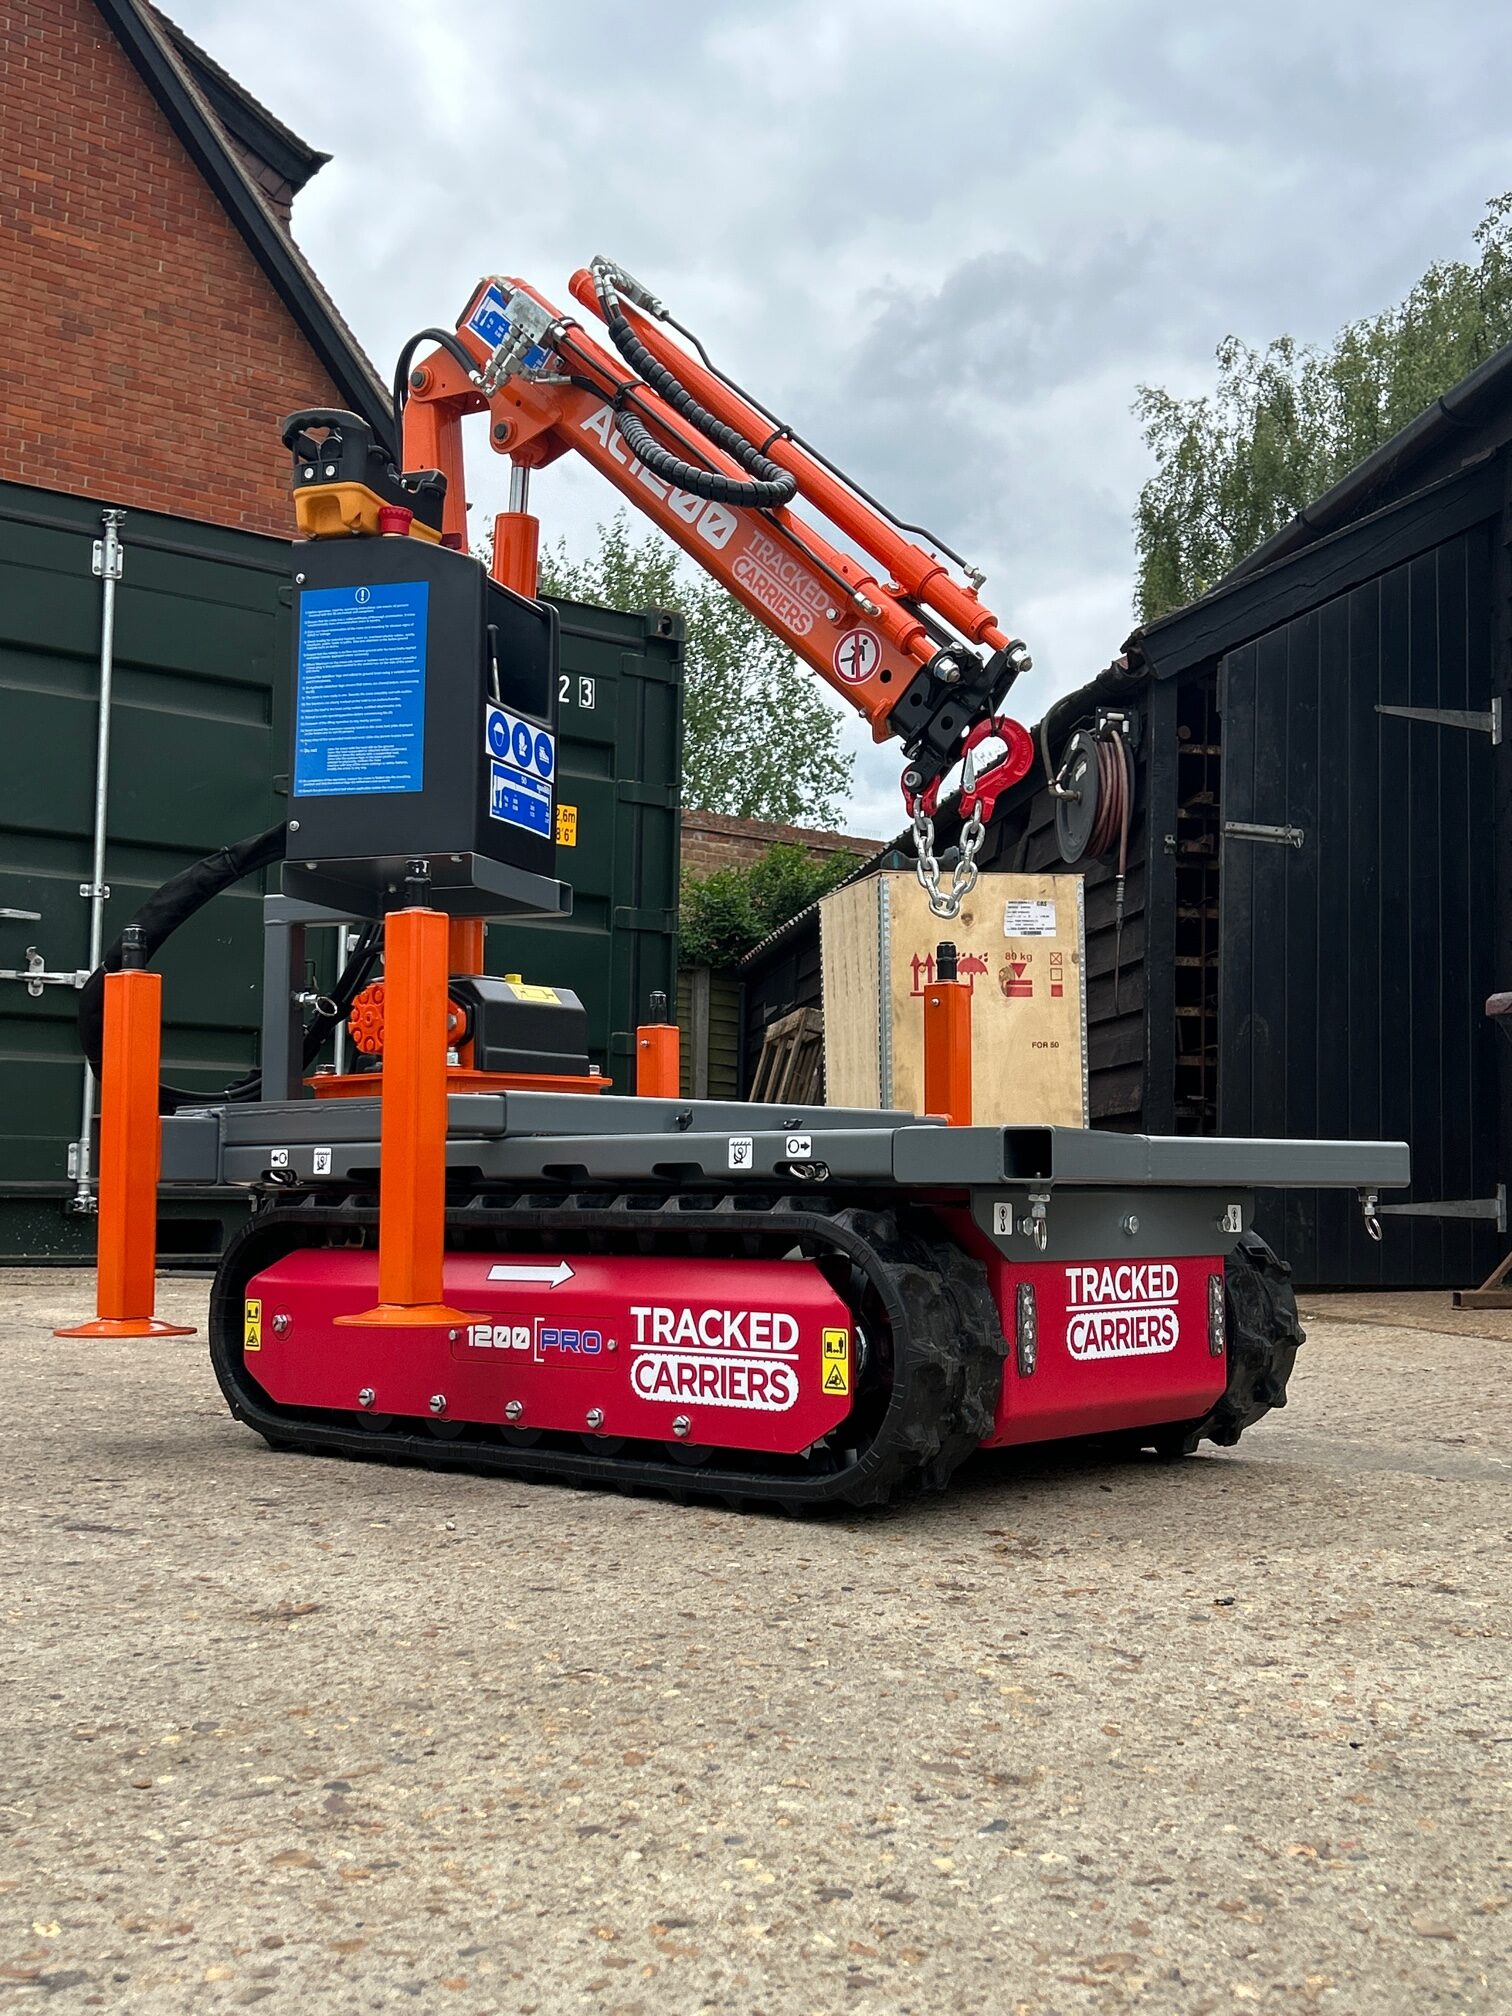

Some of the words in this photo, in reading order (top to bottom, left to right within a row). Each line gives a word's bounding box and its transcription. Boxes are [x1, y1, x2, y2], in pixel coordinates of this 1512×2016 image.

[749, 530, 830, 611] TRACKED
[733, 558, 809, 634] CARRIERS
[581, 679, 593, 708] 3
[1020, 951, 1033, 963] kg
[1031, 1041, 1049, 1049] FOR
[1050, 1041, 1060, 1049] 50
[1065, 1264, 1179, 1304] TRACKED
[466, 1324, 531, 1350] 1200
[630, 1306, 800, 1351] TRACKED
[1069, 1314, 1174, 1355] CARRIERS
[634, 1359, 791, 1405] CARRIERS
